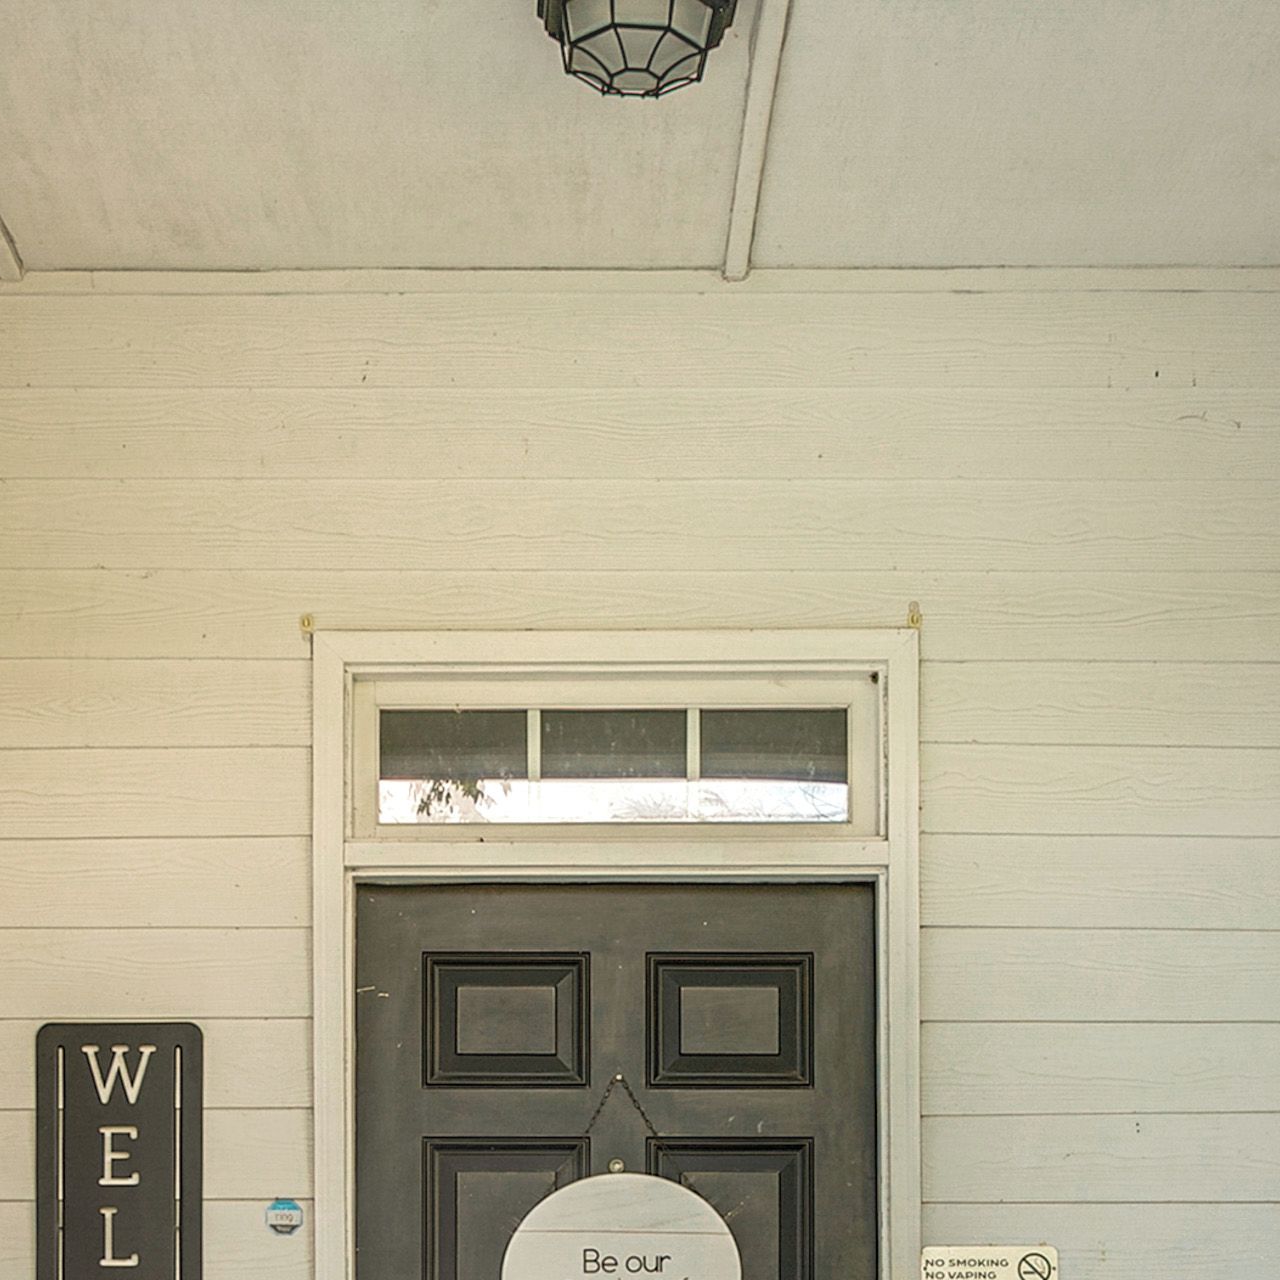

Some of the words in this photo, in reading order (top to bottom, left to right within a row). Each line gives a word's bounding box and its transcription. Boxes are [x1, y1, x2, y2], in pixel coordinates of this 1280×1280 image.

[582, 1248, 619, 1273] Be
[625, 1255, 671, 1273] our
[925, 1259, 945, 1267] NO
[948, 1259, 1009, 1267] SMOKING
[925, 1271, 945, 1279] NO
[948, 1271, 997, 1279] VAPING
